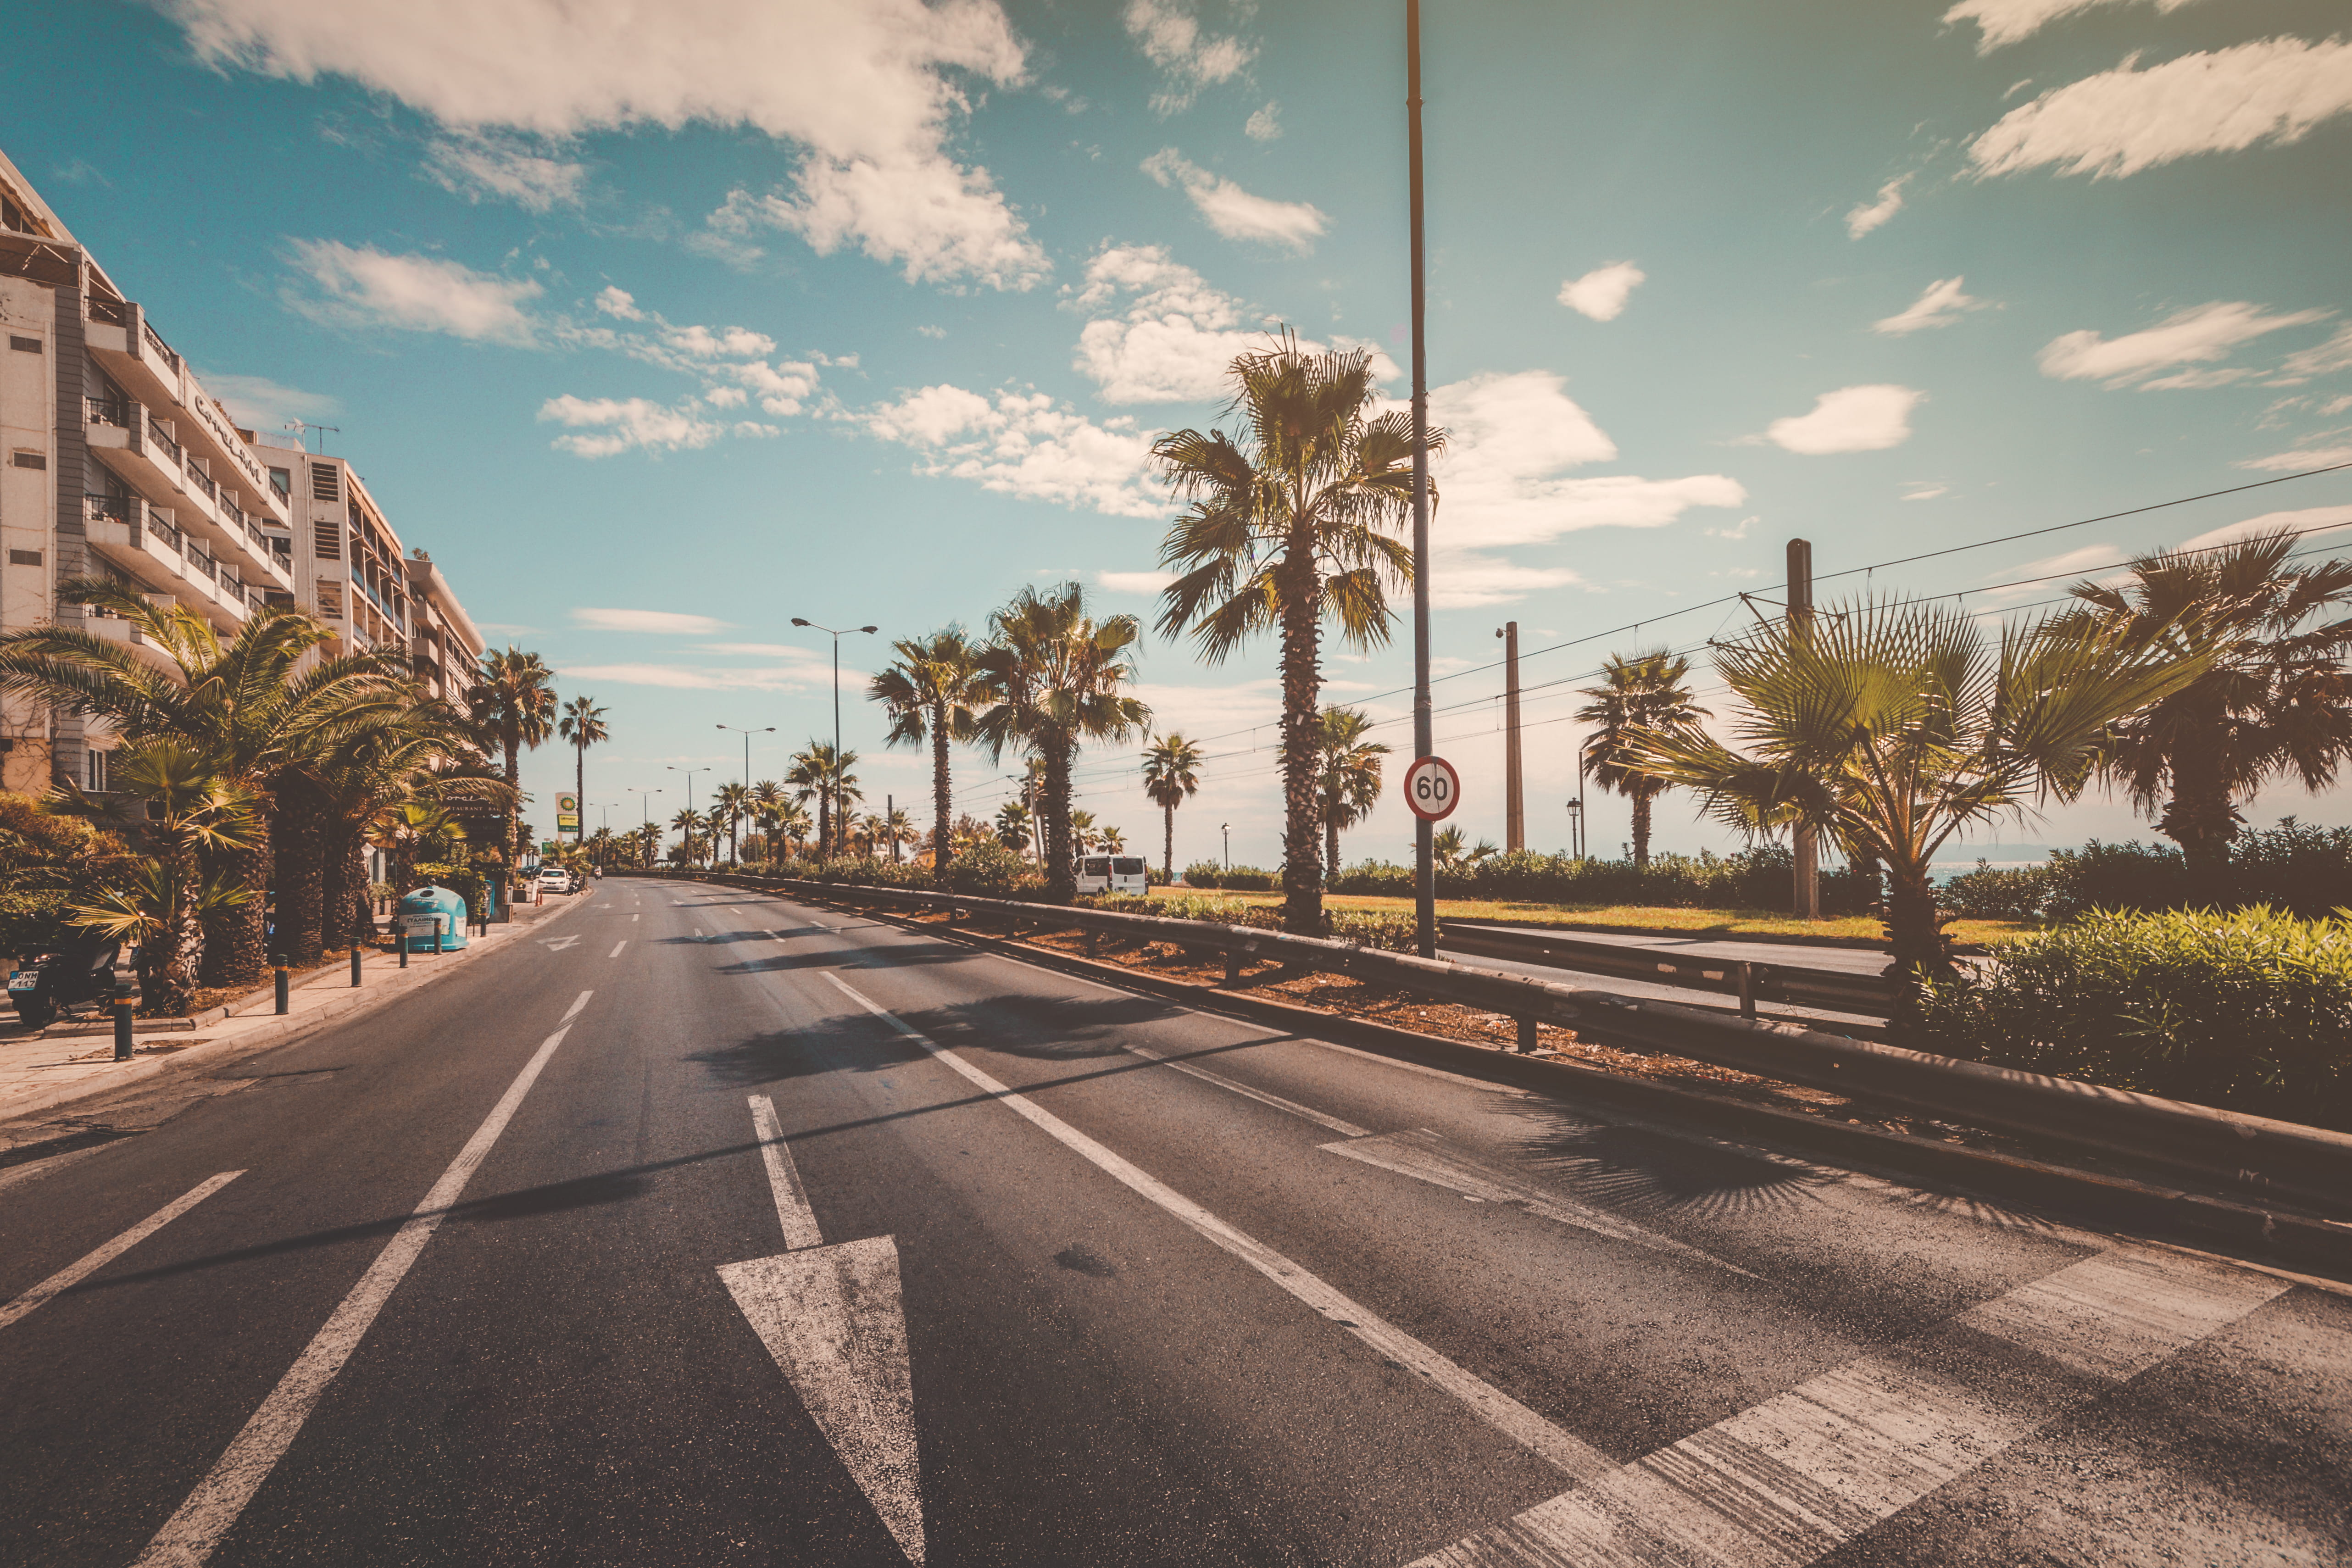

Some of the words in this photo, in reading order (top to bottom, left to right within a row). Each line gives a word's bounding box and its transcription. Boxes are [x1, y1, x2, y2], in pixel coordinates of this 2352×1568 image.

[195, 395, 234, 450] Coral
[240, 449, 262, 484] Hotel
[1417, 776, 1447, 801] 60
